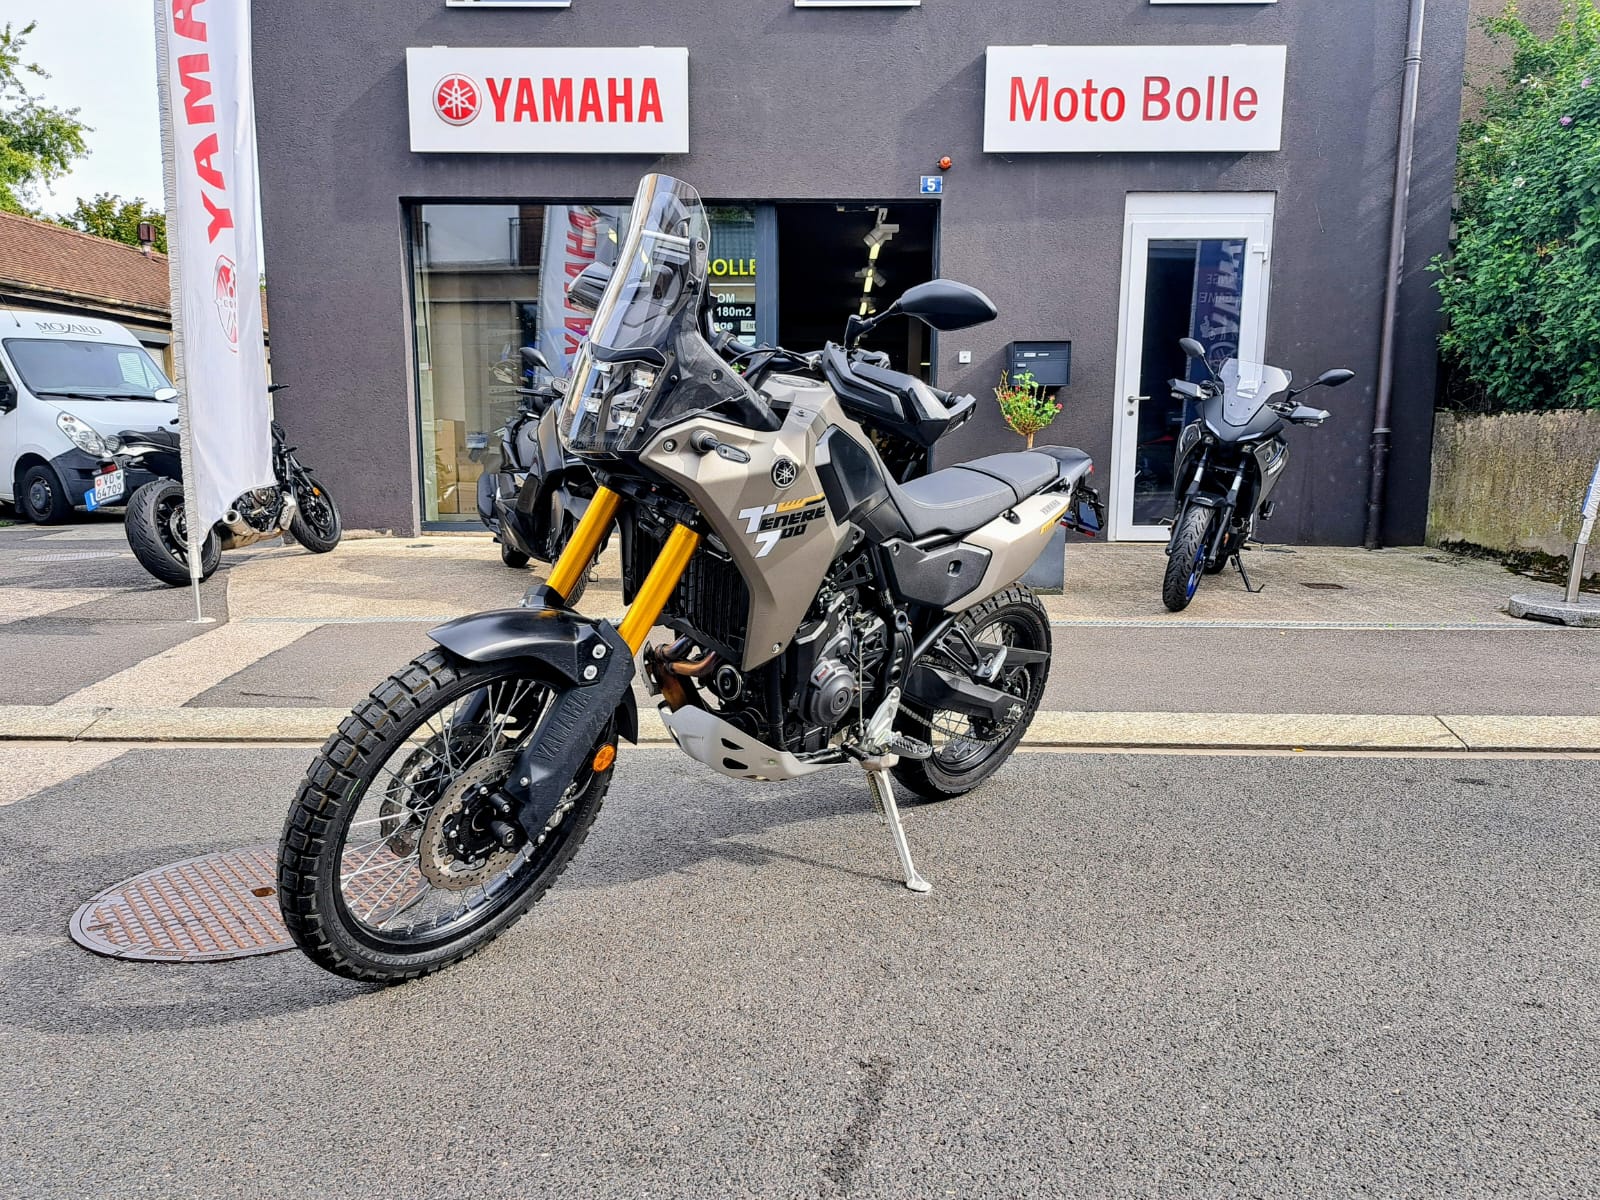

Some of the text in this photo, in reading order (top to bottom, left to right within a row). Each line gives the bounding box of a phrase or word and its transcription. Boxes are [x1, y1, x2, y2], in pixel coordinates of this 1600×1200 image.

[485, 77, 664, 122] YAMAHA
[1009, 76, 1258, 122] Moto Bolle
[927, 178, 936, 191] 5
[716, 306, 752, 317] 180m2
[34, 322, 103, 336] MOYARD
[104, 474, 114, 485] VD
[97, 483, 122, 499] 64709
[755, 523, 807, 559] 700
[528, 688, 592, 761] YAMAHA
